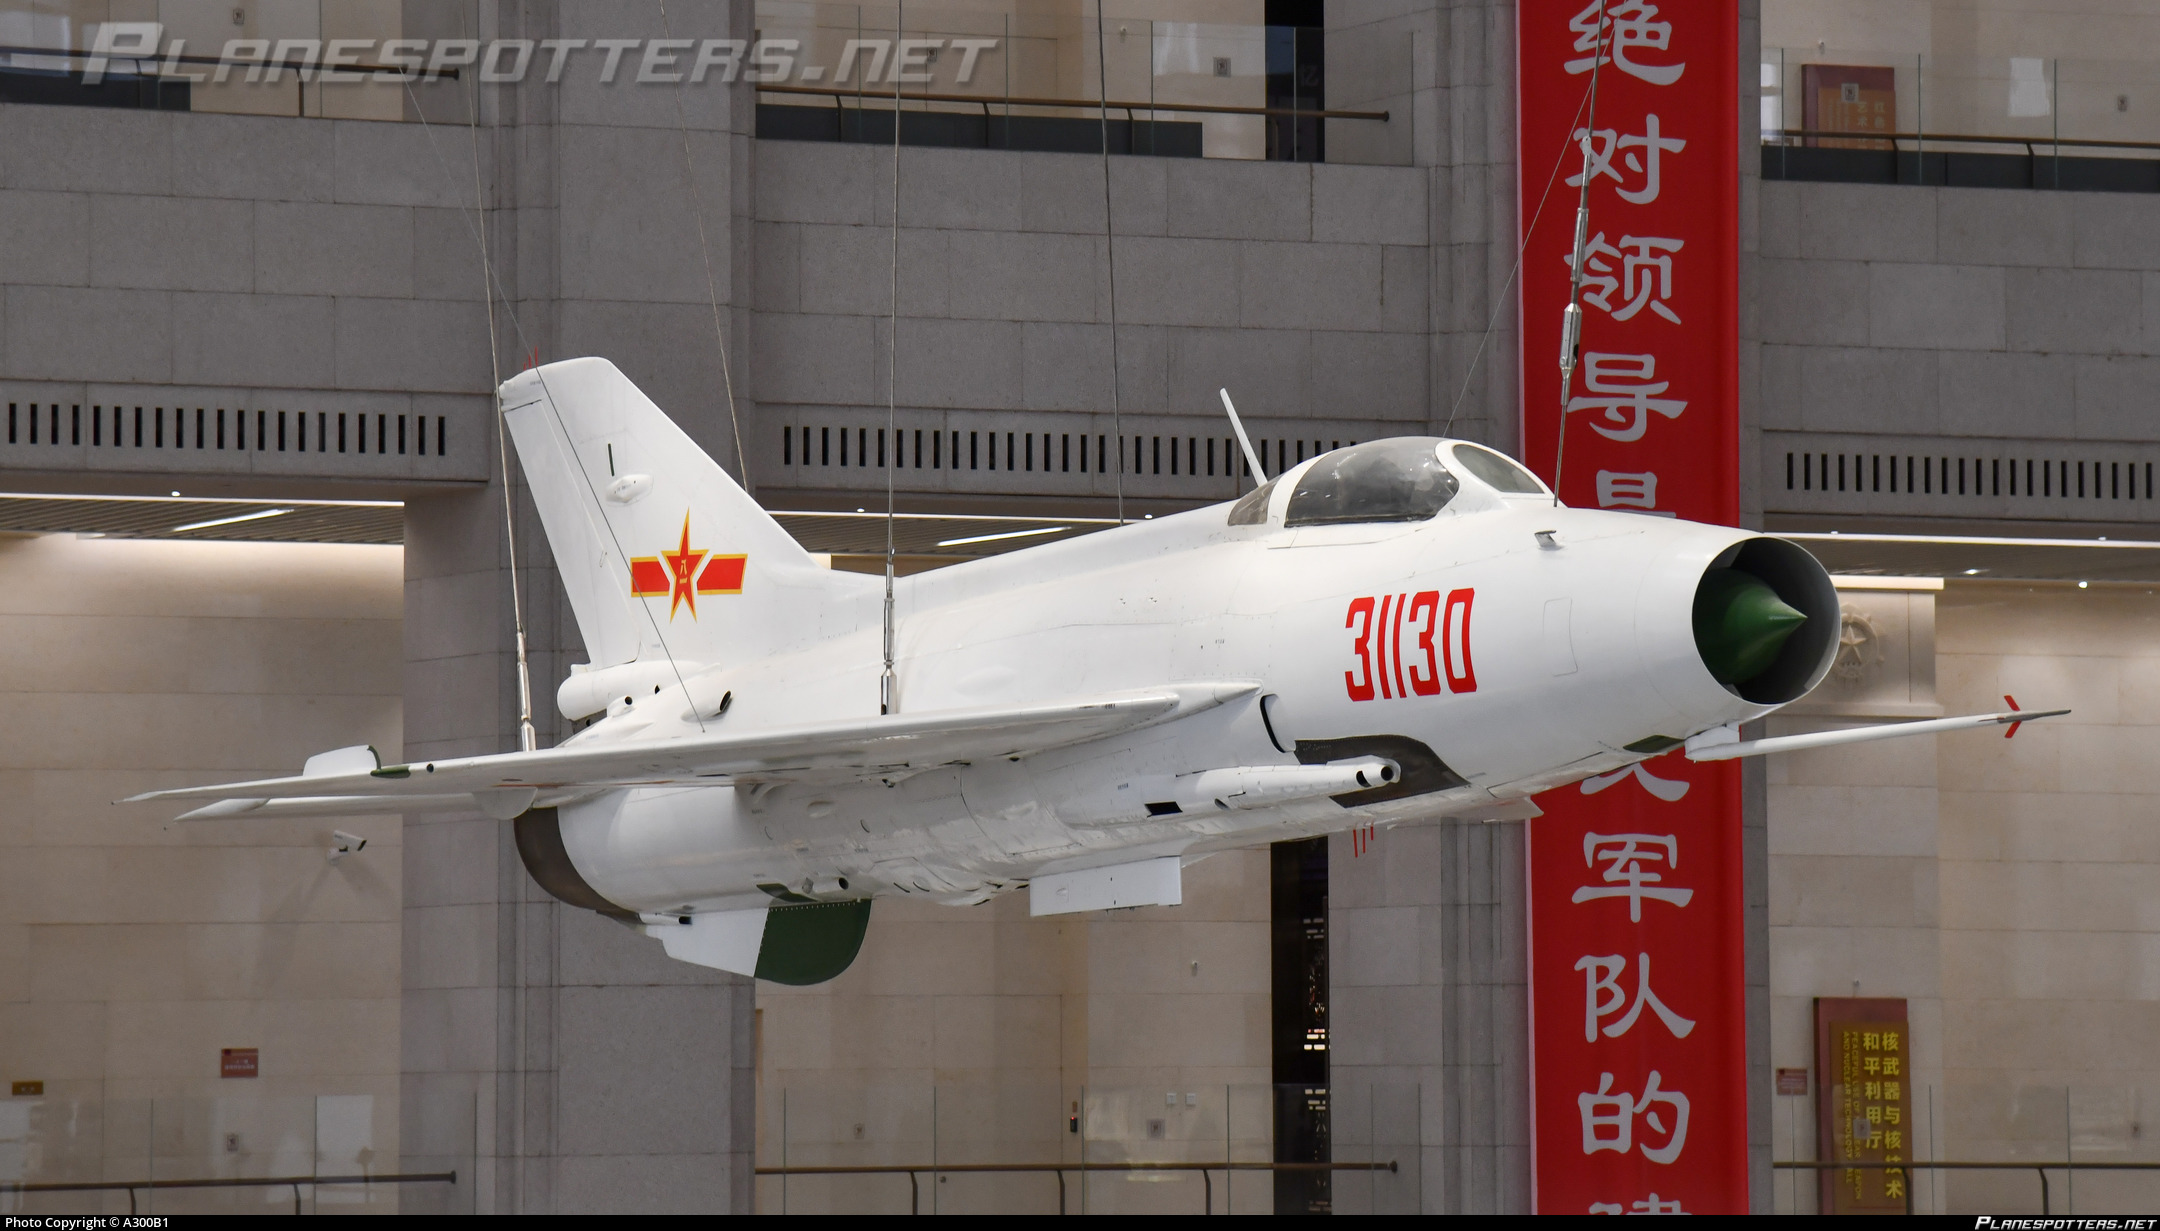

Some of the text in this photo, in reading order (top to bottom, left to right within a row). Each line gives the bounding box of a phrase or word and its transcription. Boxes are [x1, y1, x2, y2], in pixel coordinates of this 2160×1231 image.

[1345, 587, 1477, 702] 31130
[1863, 1031, 1881, 1149] 和平利用厅
[1882, 1031, 1902, 1199] 核武器与核技术
